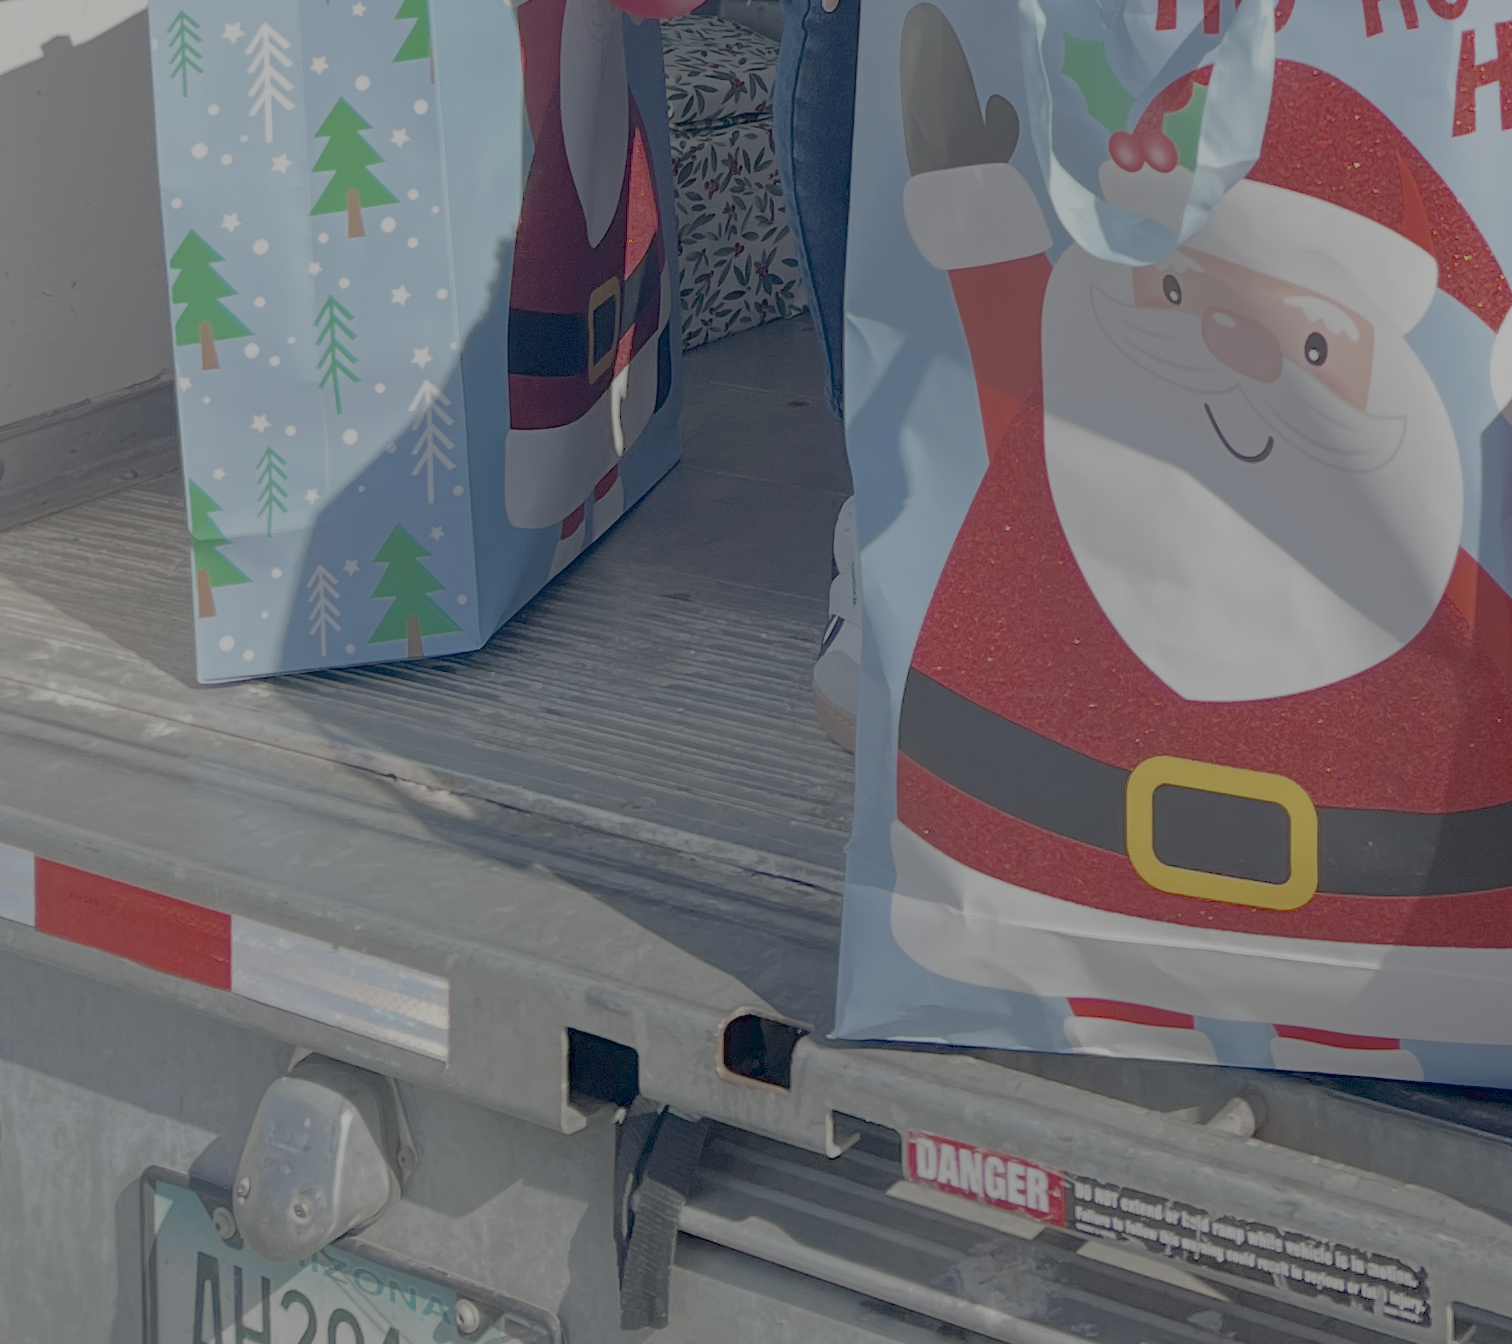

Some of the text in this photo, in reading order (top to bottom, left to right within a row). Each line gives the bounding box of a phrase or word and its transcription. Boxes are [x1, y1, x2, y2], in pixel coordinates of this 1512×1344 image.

[916, 1135, 1052, 1214] DANGER
[1074, 1206, 1111, 1229] Failure
[1112, 1217, 1124, 1232] to
[1125, 1220, 1158, 1241] follow
[1159, 1230, 1180, 1247] this
[1181, 1238, 1224, 1262] warning
[1226, 1250, 1255, 1268] could
[1257, 1258, 1289, 1277] result
[1291, 1264, 1302, 1280] in
[1304, 1270, 1345, 1292] serious
[1347, 1282, 1360, 1295] or
[1094, 1187, 1118, 1208] NOT
[1120, 1198, 1162, 1220] extend
[1165, 1209, 1181, 1225] or
[1211, 1222, 1245, 1245] ramp
[1247, 1231, 1282, 1252] while
[1284, 1240, 1333, 1265] vehicle
[1335, 1251, 1349, 1270] is
[1350, 1255, 1365, 1275] in
